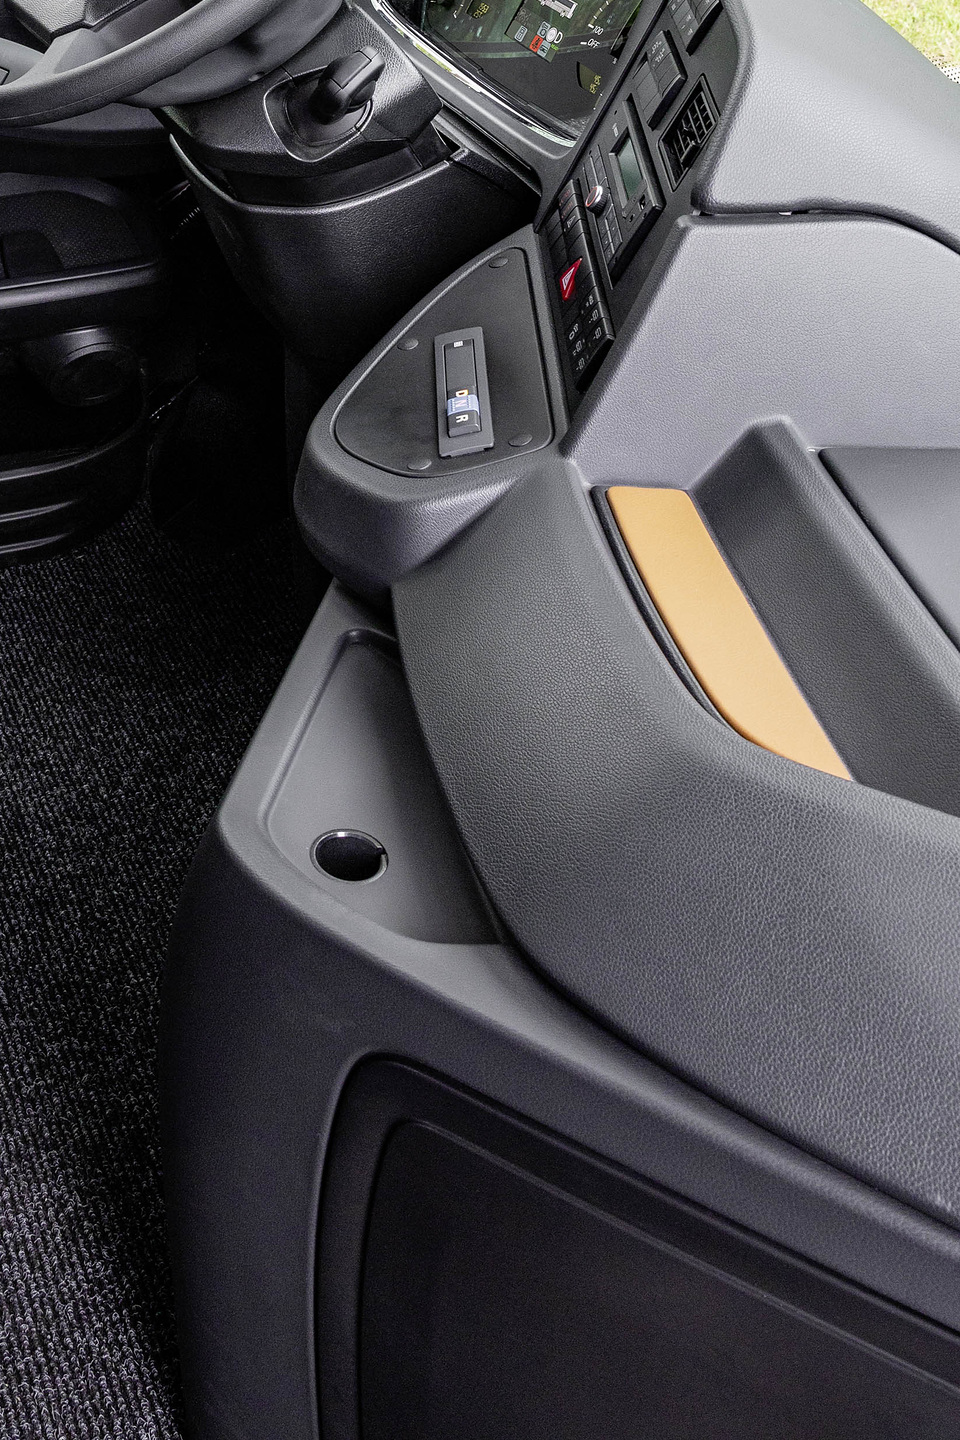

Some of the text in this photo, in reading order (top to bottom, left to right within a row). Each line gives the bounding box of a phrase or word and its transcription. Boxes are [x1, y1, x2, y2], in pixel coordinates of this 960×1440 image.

[593, 25, 604, 36] 100
[555, 31, 563, 44] D
[587, 38, 601, 49] OFF
[455, 389, 469, 423] D N R
